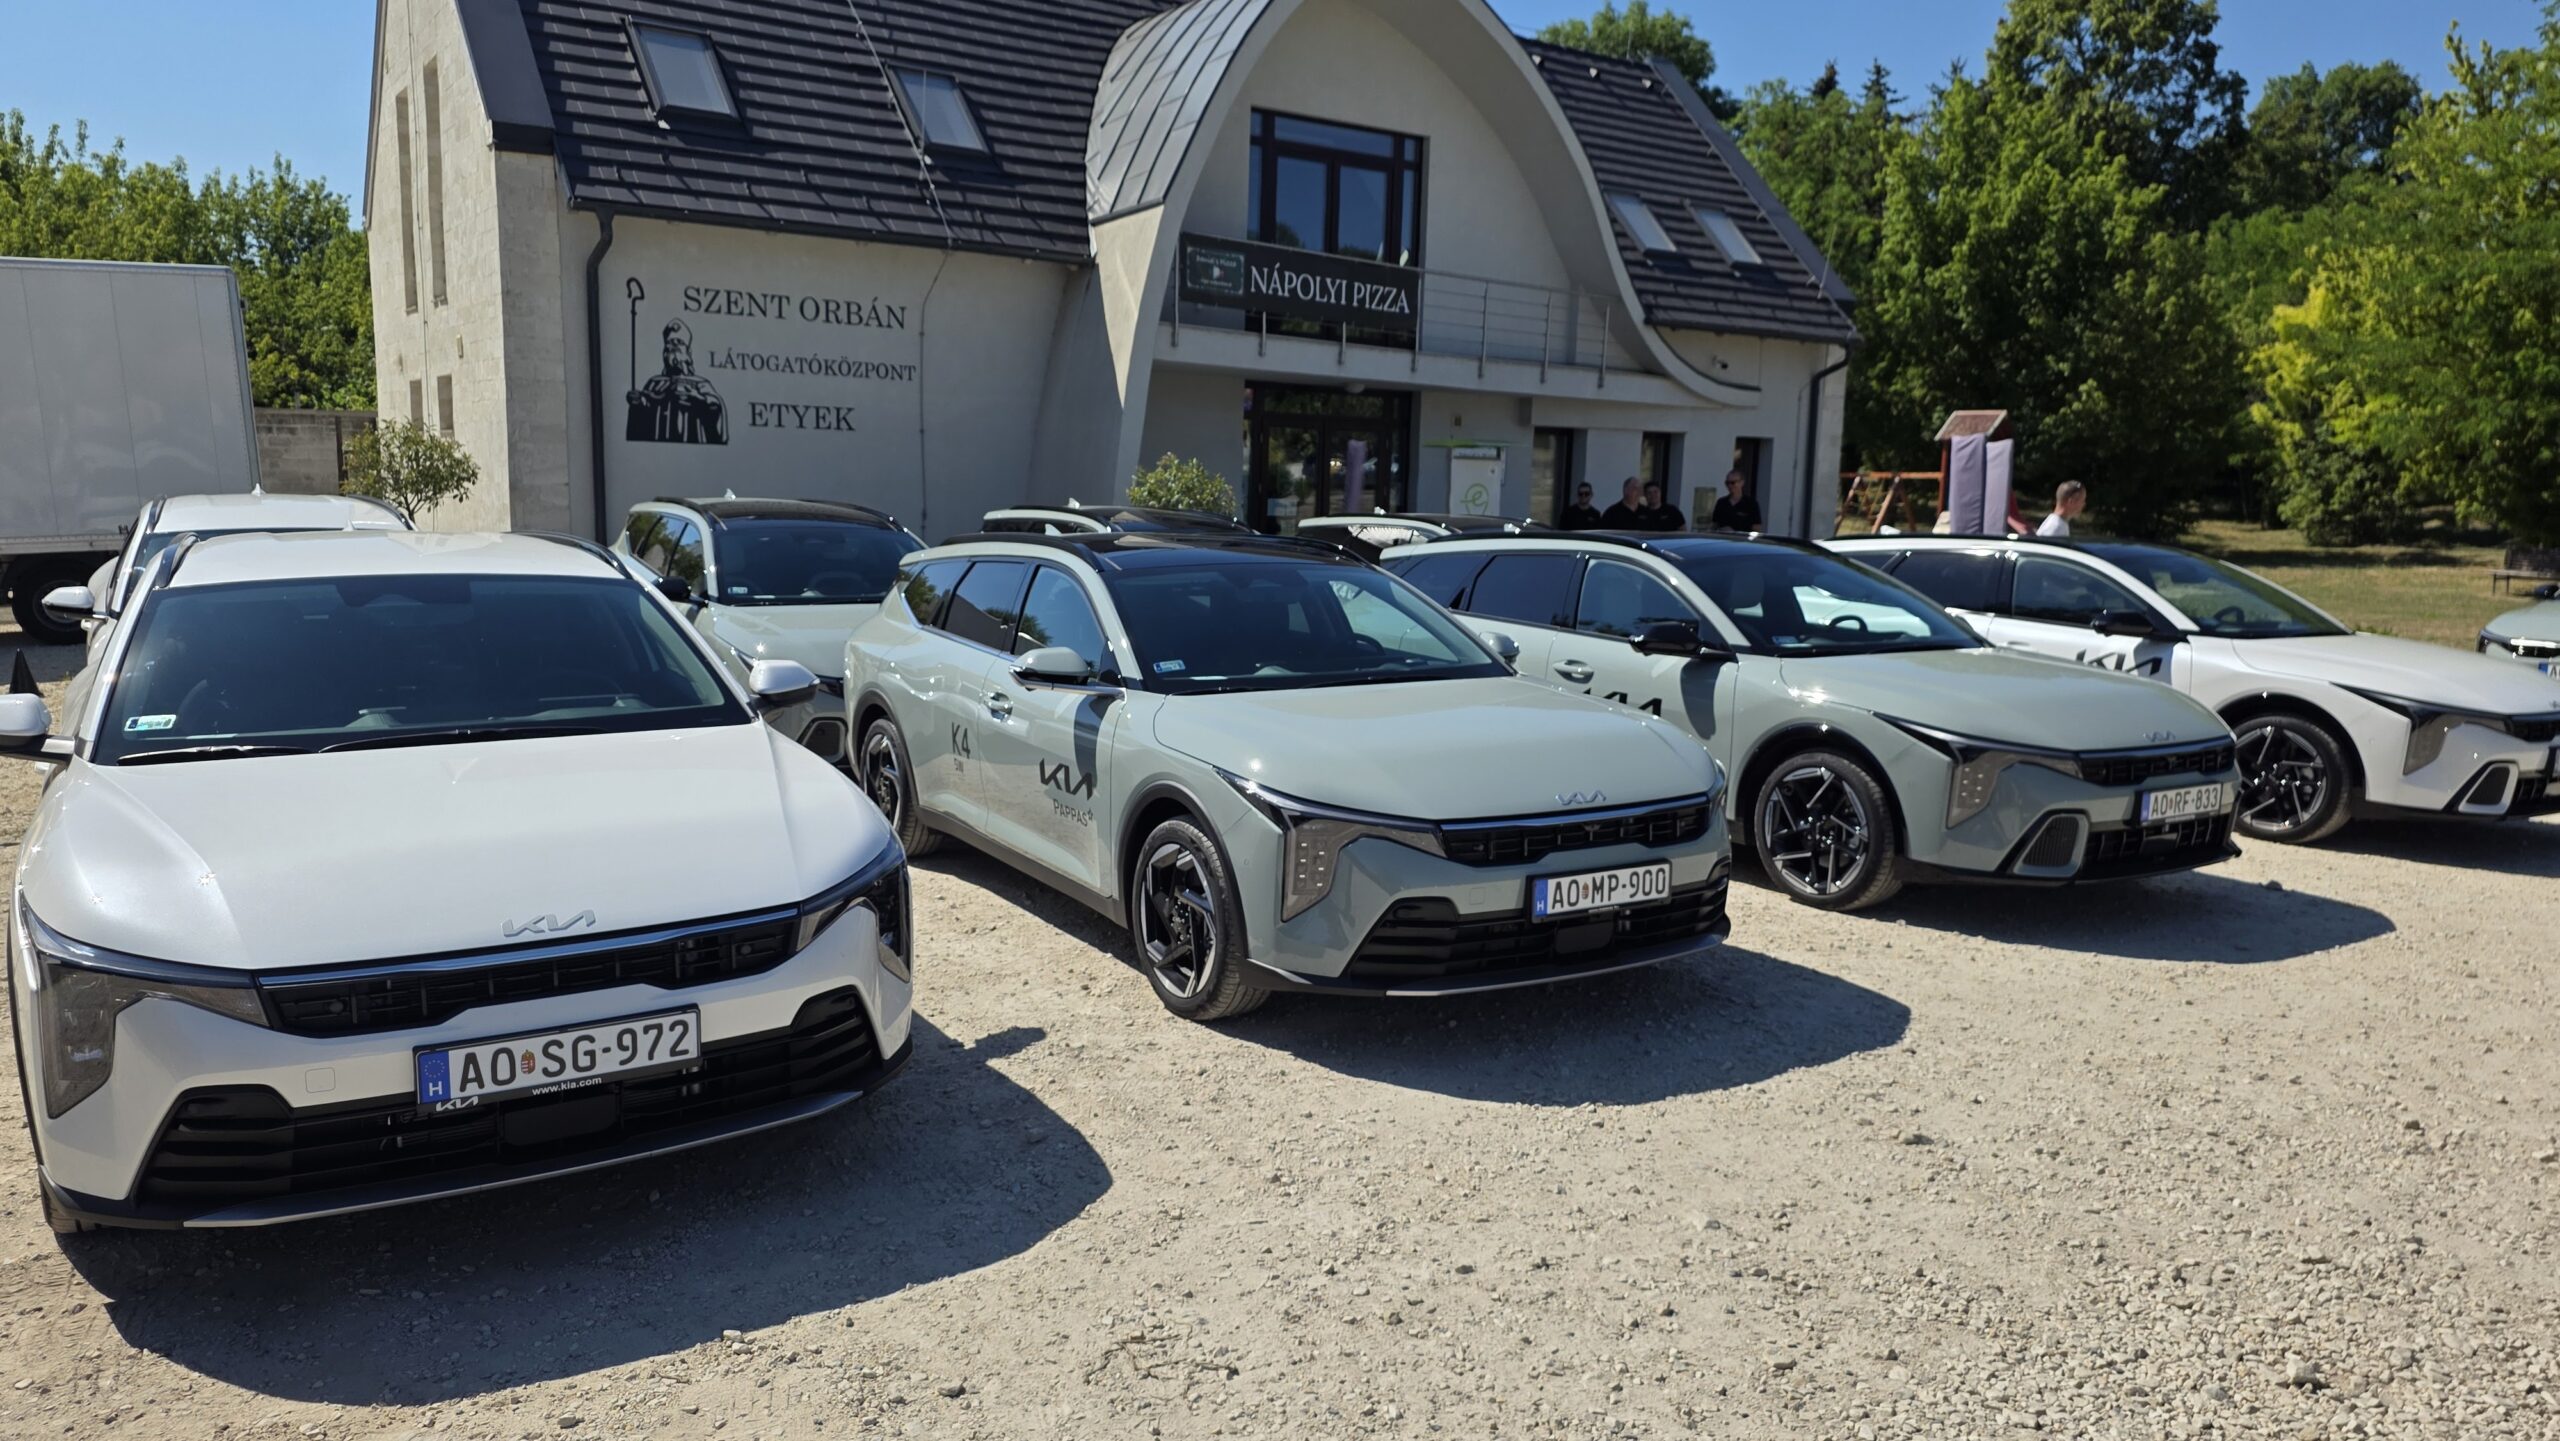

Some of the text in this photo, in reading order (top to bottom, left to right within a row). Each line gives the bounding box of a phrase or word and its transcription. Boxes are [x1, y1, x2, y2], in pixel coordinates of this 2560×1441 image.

[1250, 262, 1411, 314] NÁPOLYI PIZZA
[683, 286, 907, 329] SZENT ORBÁN
[708, 347, 917, 382] LÁTOGATÓKÖZPONT
[748, 402, 856, 432] ETYEK
[951, 721, 971, 760] K4
[1039, 758, 1094, 800] KIA
[1052, 798, 1088, 828] PAPPAS
[1591, 867, 1667, 904] MP-900
[1536, 900, 1545, 911] H
[501, 908, 597, 938] KIA
[541, 1019, 690, 1078] SG-972
[428, 1080, 443, 1099] H
[531, 1076, 603, 1096] www.kia.com
[435, 1095, 479, 1112] KIA
